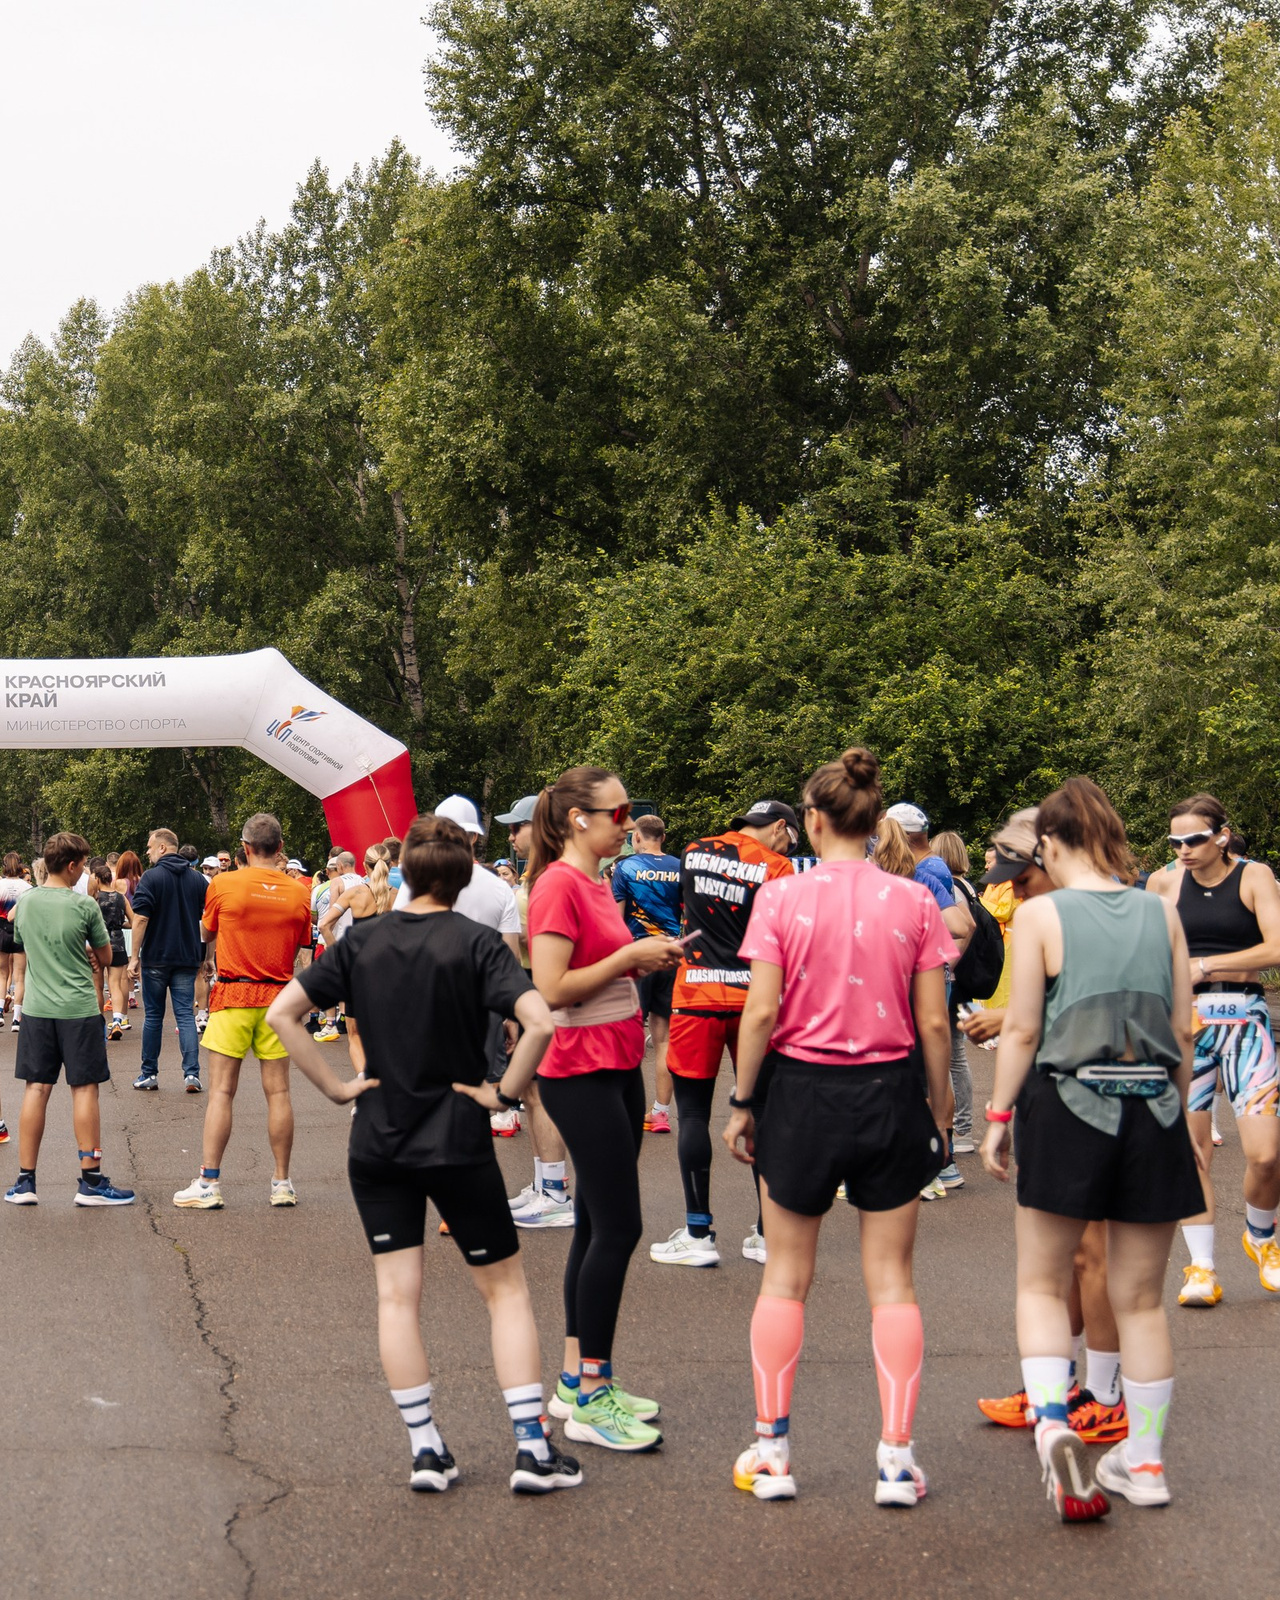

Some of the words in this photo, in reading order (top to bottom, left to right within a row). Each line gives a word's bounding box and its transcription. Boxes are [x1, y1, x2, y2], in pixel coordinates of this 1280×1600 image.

[5, 671, 166, 689] КРАСНОЯРСКИЙ
[6, 690, 58, 708] КРАЙ
[6, 719, 126, 731] МИНИСТЕРСТВО
[129, 718, 187, 731] СПОРТА
[286, 740, 320, 766] ПОДГОТОВКИ
[292, 733, 310, 748] ЦЕНТР
[308, 745, 344, 771] СПОРТИВНОЙ
[636, 870, 680, 882] МОЛНИ
[685, 852, 768, 884] СИБИРСКИЙ
[694, 876, 746, 905] МАУГЛИ
[1207, 1004, 1237, 1016] 148
